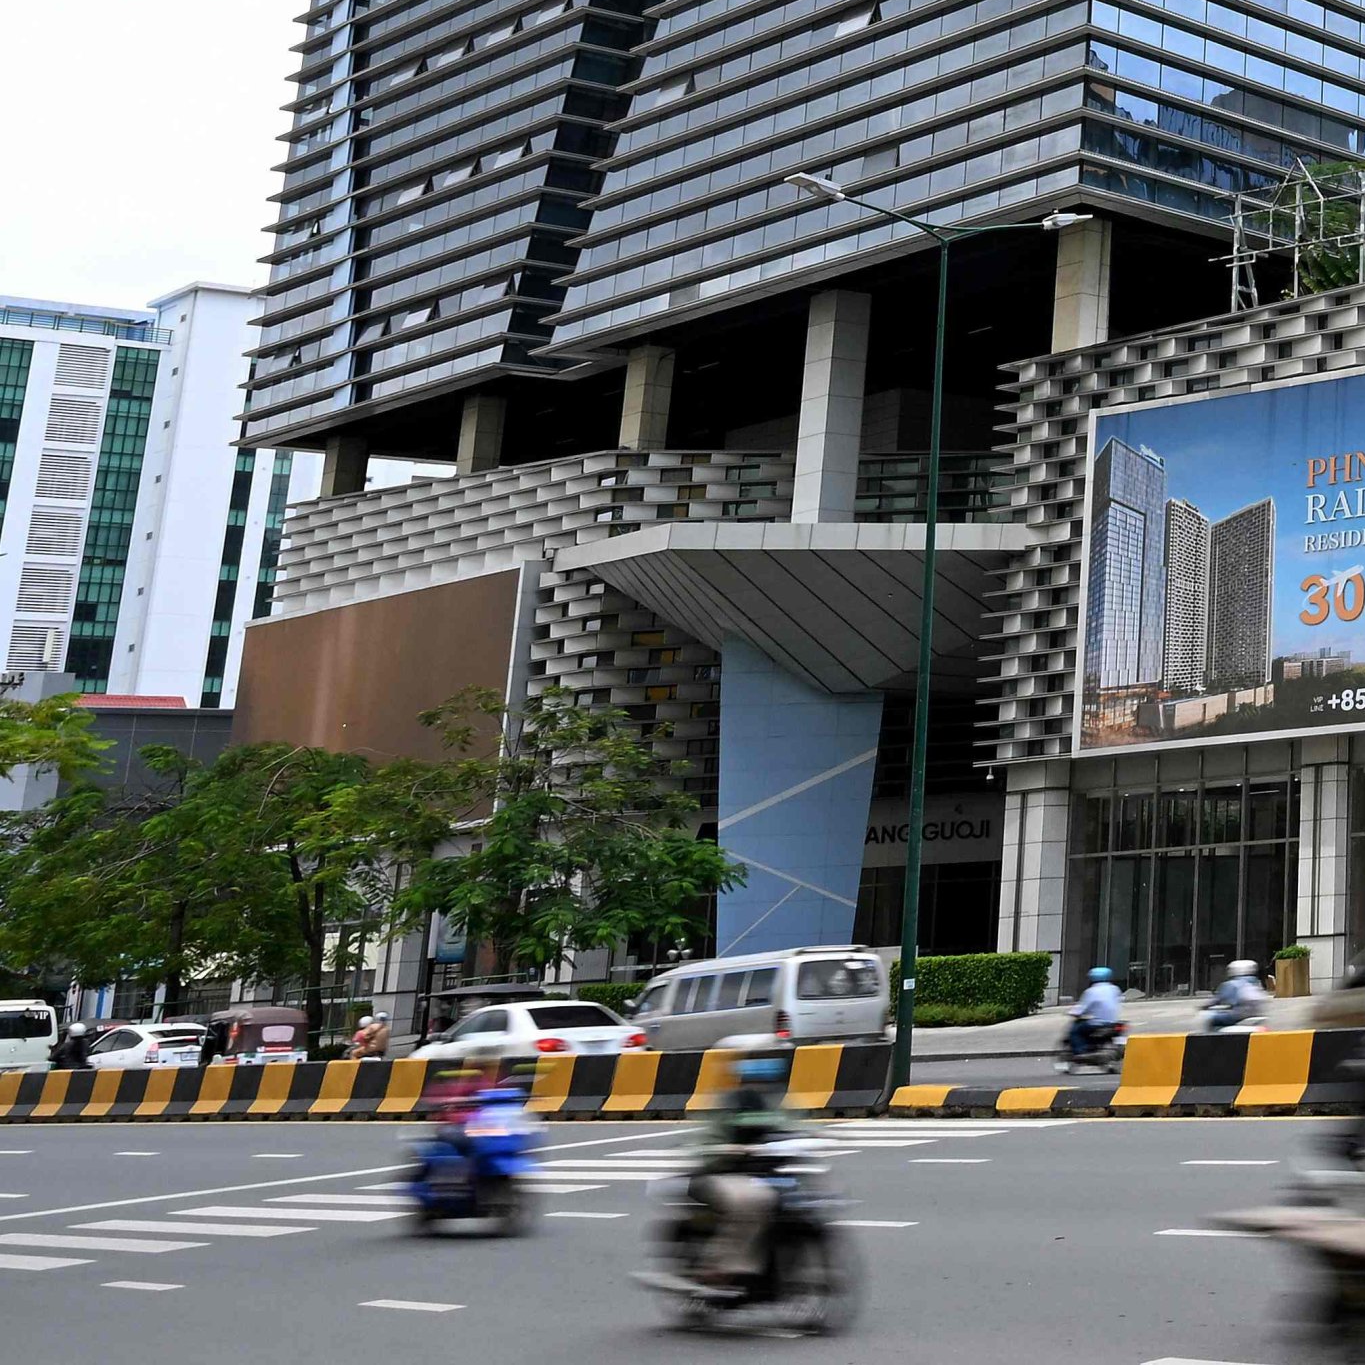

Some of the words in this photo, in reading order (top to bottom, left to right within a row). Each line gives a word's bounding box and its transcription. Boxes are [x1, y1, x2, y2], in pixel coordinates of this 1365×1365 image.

[1313, 695, 1324, 703] VIP
[1310, 704, 1324, 712] LINE
[921, 819, 991, 841] GUOJI
